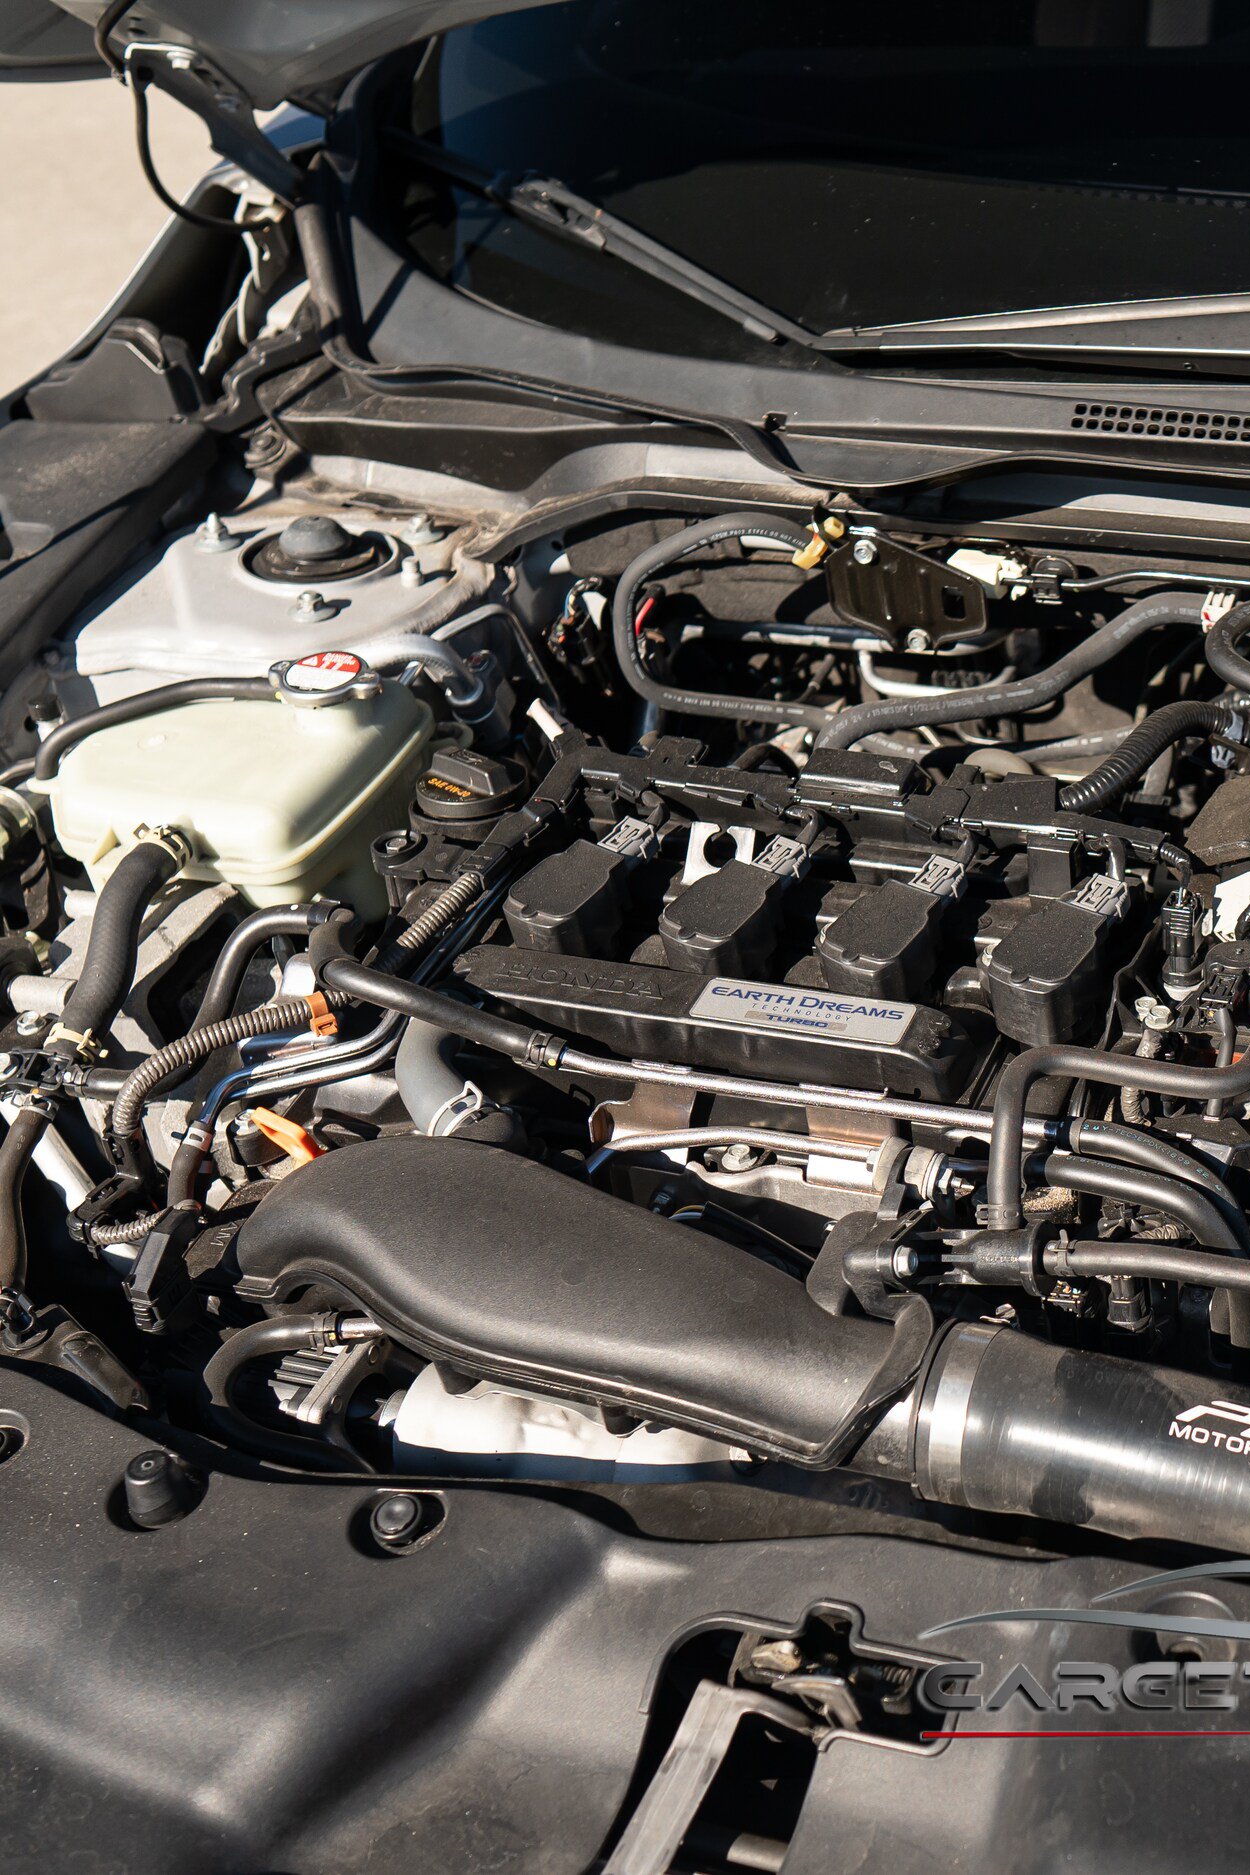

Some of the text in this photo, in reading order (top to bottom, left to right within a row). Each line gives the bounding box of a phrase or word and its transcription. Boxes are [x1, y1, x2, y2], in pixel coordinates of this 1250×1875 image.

[494, 963, 665, 1000] HONDA
[711, 986, 904, 1021] EARTH DREAMS
[752, 1002, 852, 1022] TECHNOLOGY
[766, 1014, 829, 1029] TURBO
